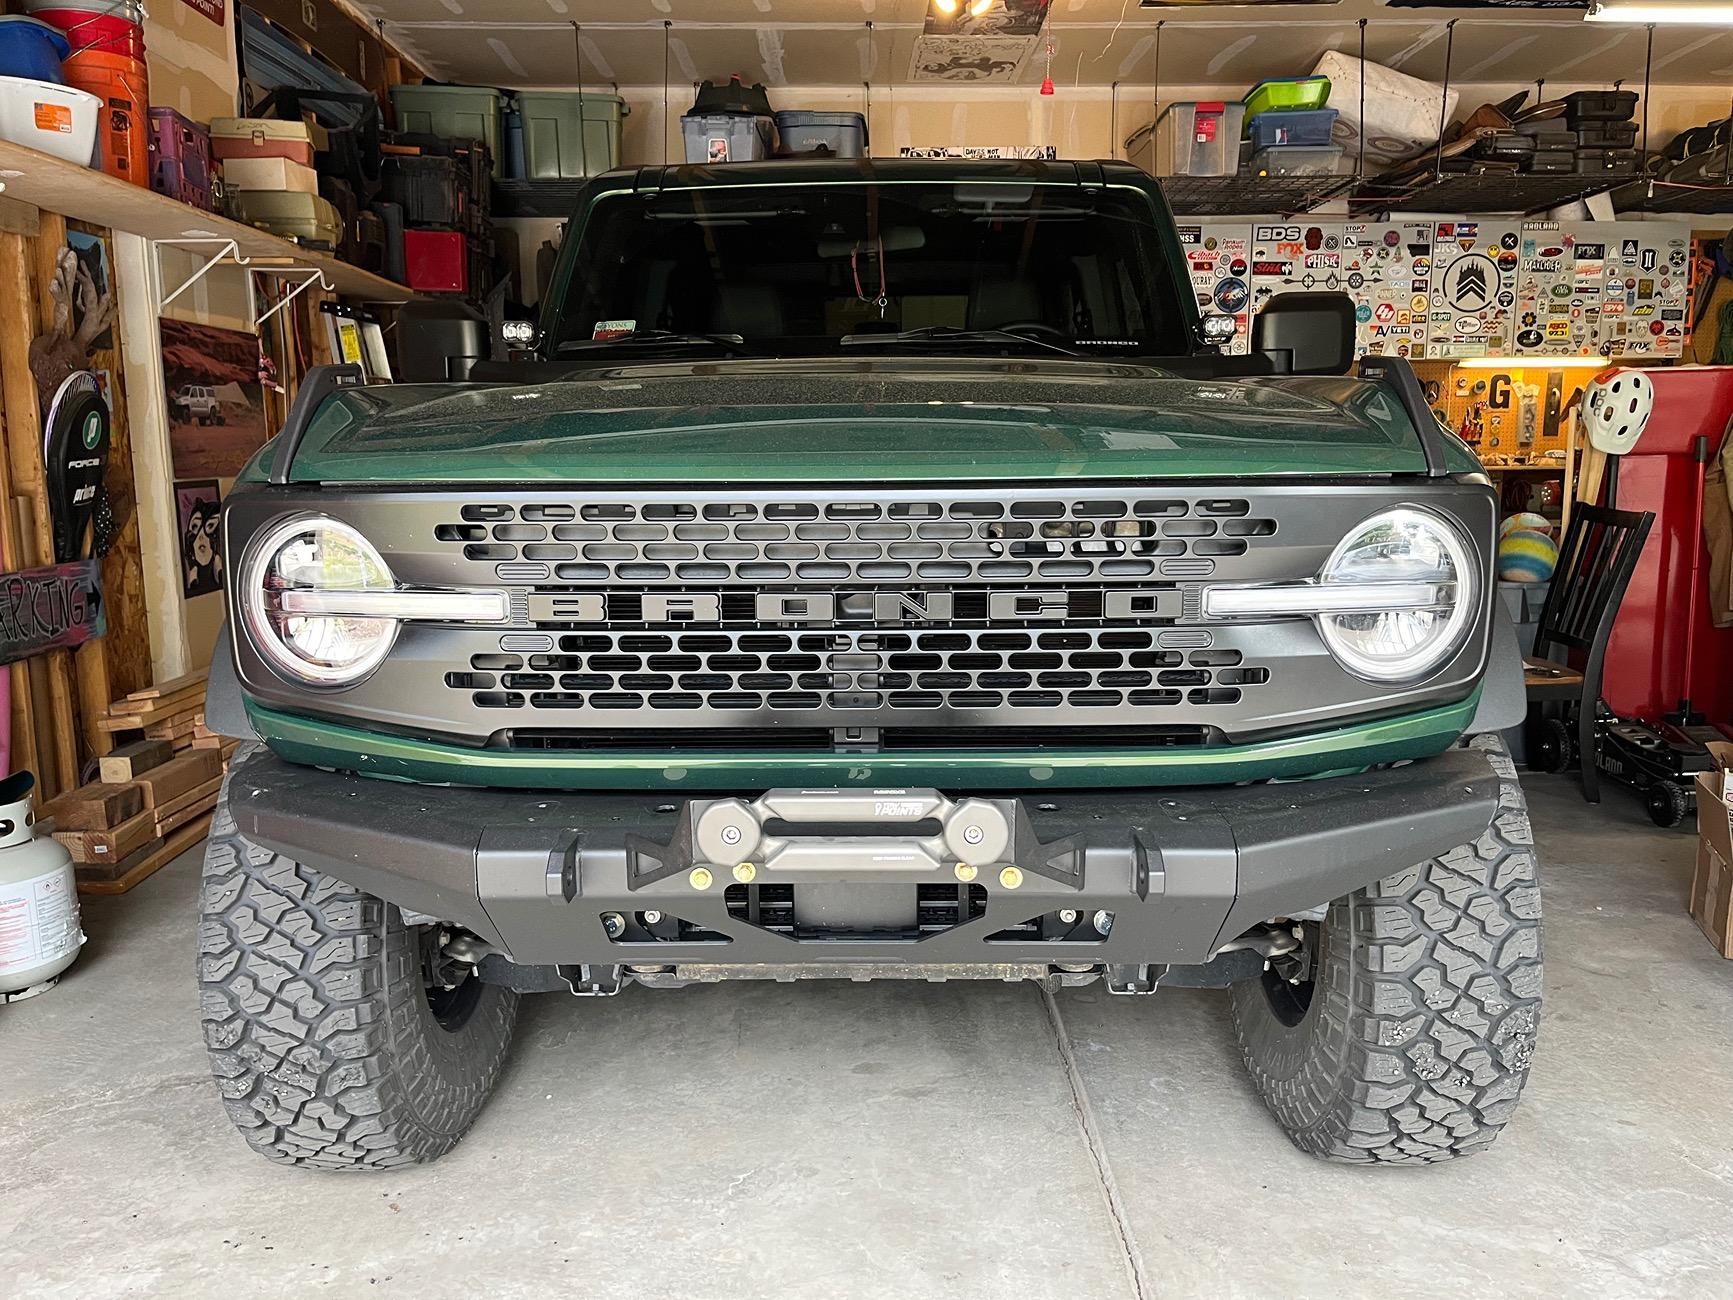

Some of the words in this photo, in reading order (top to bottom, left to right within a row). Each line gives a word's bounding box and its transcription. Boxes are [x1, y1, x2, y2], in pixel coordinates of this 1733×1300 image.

[1523, 222, 1559, 231] BADLAND
[1256, 227, 1301, 241] BDS
[1276, 242, 1304, 256] FOX
[1435, 243, 1457, 254] JKS
[1577, 246, 1597, 256] FOX
[1488, 374, 1511, 410] G
[1593, 388, 1607, 418] POC
[68, 458, 100, 470] FORCE
[528, 591, 1183, 622] BRONCO
